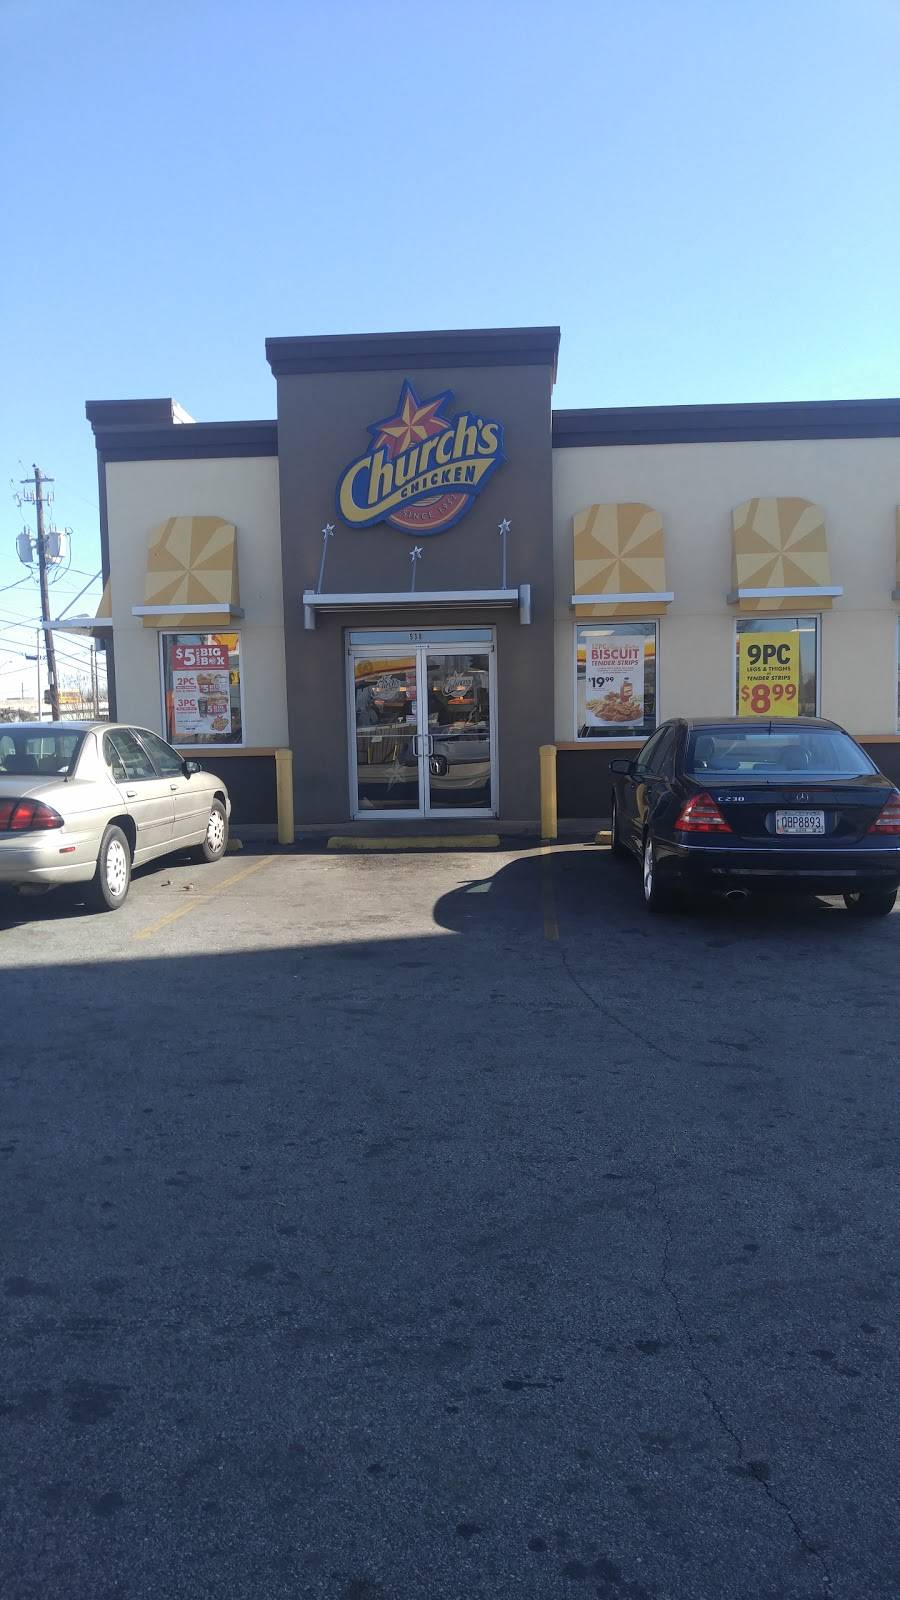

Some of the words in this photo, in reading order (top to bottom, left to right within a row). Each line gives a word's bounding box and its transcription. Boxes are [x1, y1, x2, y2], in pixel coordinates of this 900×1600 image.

[339, 415, 499, 522] Church's
[400, 464, 476, 498] CHICKEN
[175, 647, 196, 666] $5
[200, 647, 221, 657] BIG
[591, 648, 640, 660] BISCUIT
[747, 643, 791, 666] 9PC
[200, 656, 225, 666] BOX
[177, 677, 195, 686] 2PC
[177, 698, 196, 707] 3PC
